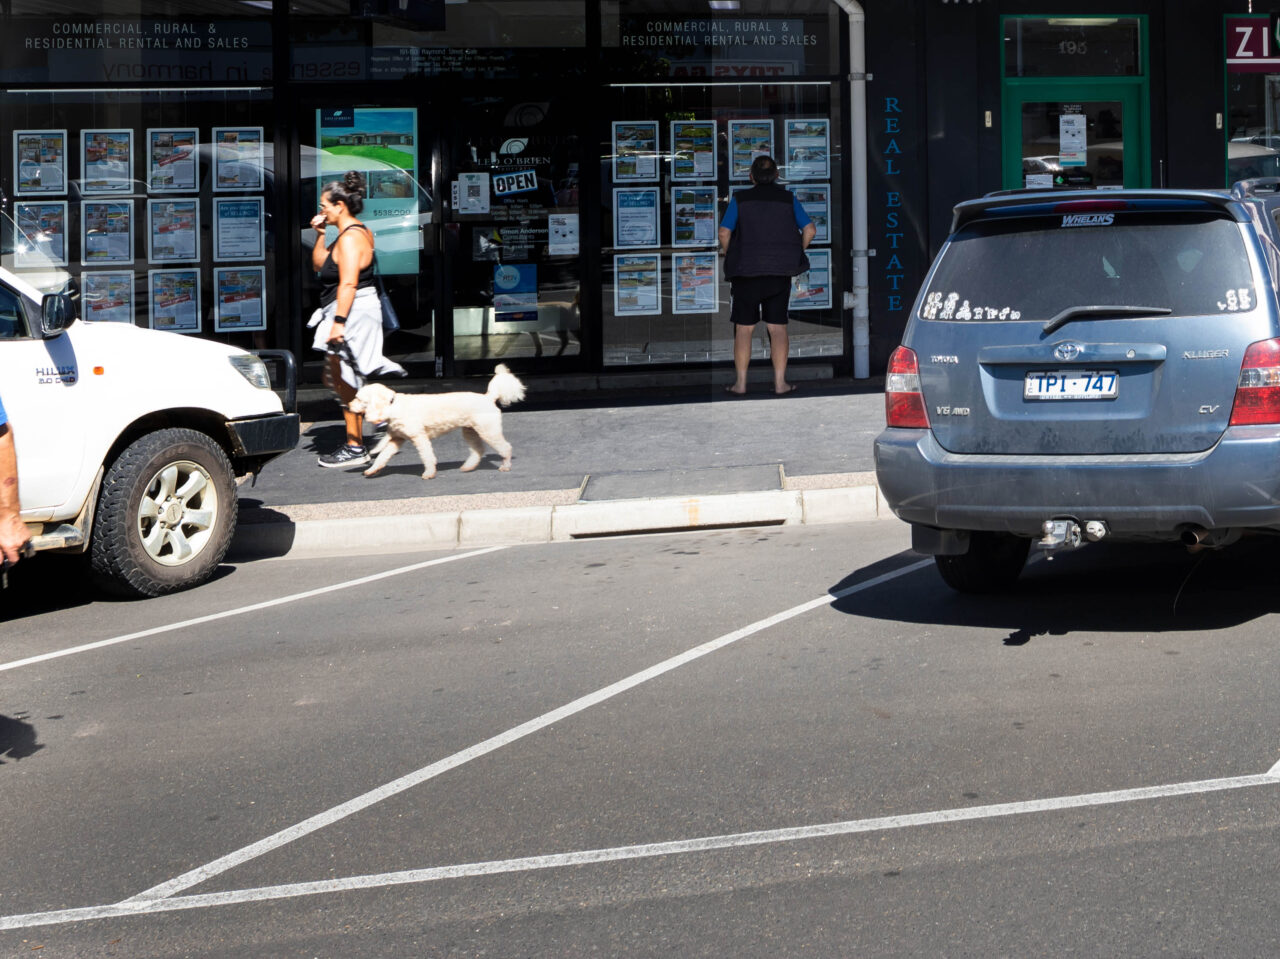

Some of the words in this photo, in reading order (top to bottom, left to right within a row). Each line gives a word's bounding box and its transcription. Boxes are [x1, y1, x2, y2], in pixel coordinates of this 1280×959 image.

[52, 22, 147, 35] COMMERCIAL,
[154, 22, 196, 34] RURAL
[208, 23, 216, 33] &
[646, 21, 729, 33] COMMERCIAL,
[734, 21, 772, 32] RURAL
[781, 22, 789, 32] &
[25, 37, 113, 49] RESIDENTIAL
[119, 37, 169, 49] RENTAL
[175, 37, 202, 48] AND
[207, 37, 249, 49] SALES
[622, 35, 699, 46] RESIDENTIAL
[704, 35, 748, 46] RENTAL
[753, 35, 776, 46] AND
[781, 35, 817, 46] SALES
[884, 97, 903, 175] REAL
[495, 172, 536, 192] OPEN
[1061, 213, 1115, 225] WHELANS
[884, 191, 905, 311] ESTATE
[930, 355, 959, 364] TOYOTA
[1183, 349, 1229, 359] KLUGER
[35, 366, 76, 377] HILUX
[936, 406, 951, 416] V6
[951, 407, 970, 416] AWD
[1198, 404, 1220, 415] CV
